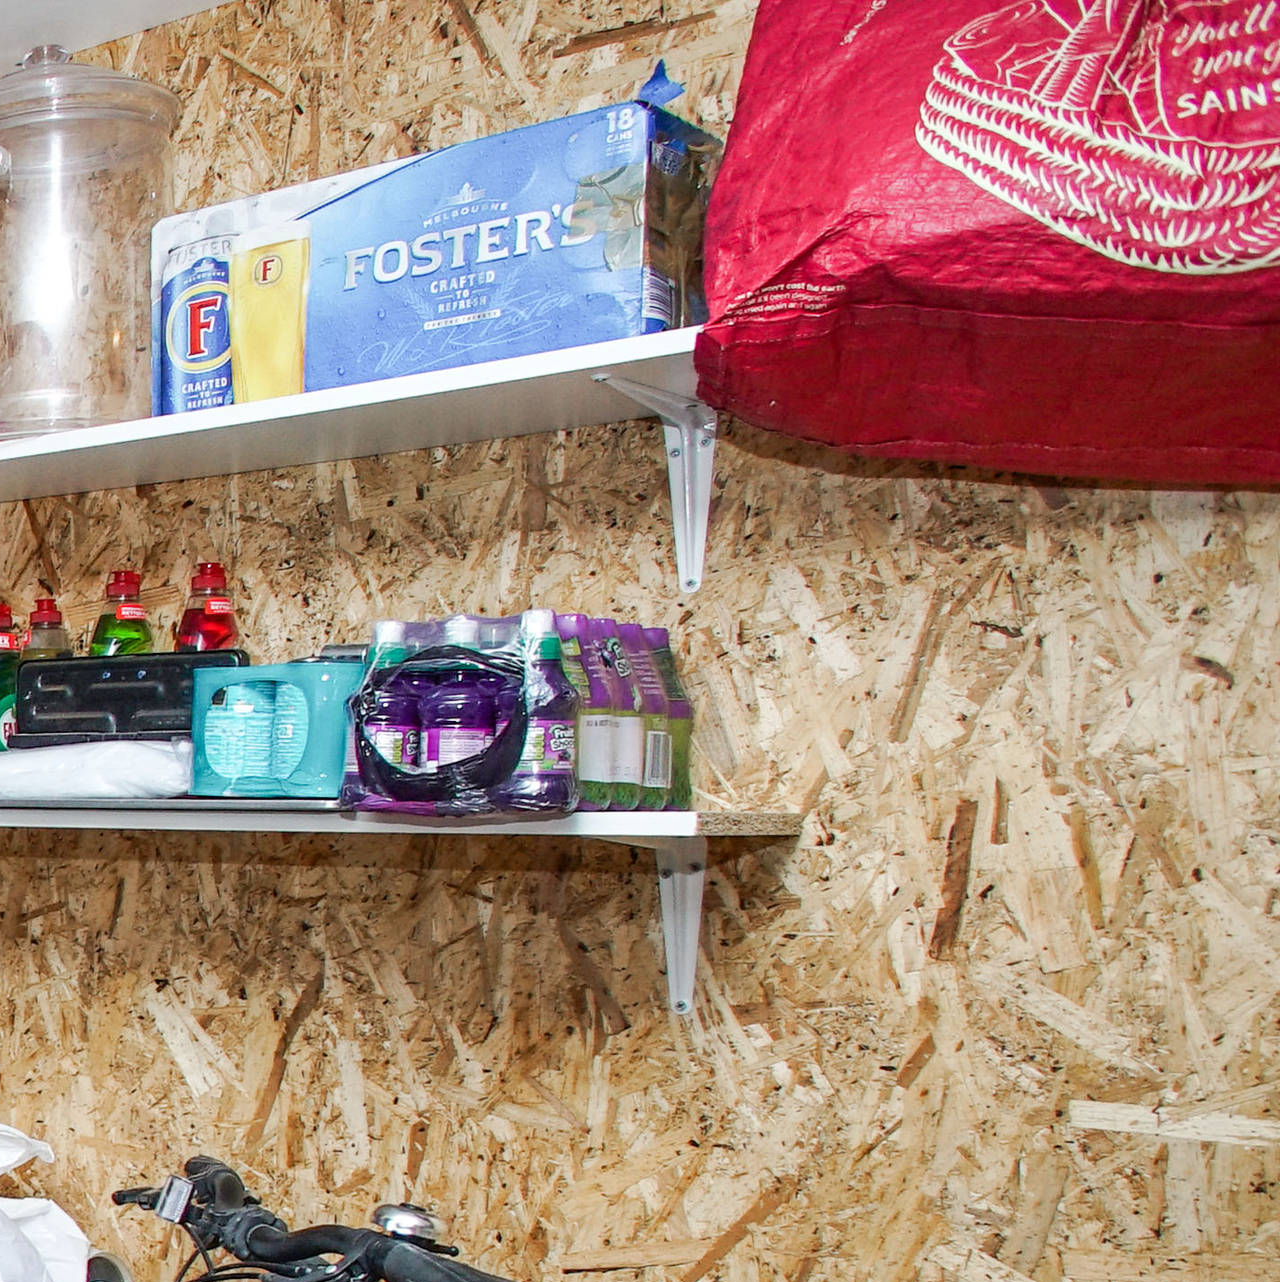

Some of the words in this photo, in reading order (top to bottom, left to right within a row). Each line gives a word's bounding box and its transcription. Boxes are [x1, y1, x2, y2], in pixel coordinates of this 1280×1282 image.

[1192, 46, 1256, 84] you
[606, 108, 633, 133] 18
[606, 131, 633, 143] CANS
[423, 201, 509, 228] MELBOURNE
[342, 203, 598, 291] FOSTER'S
[429, 270, 495, 294] CRAFTED
[438, 295, 487, 313] REFRESH
[455, 289, 470, 300] TO
[187, 295, 223, 359] F
[181, 377, 228, 394] CRAFTED
